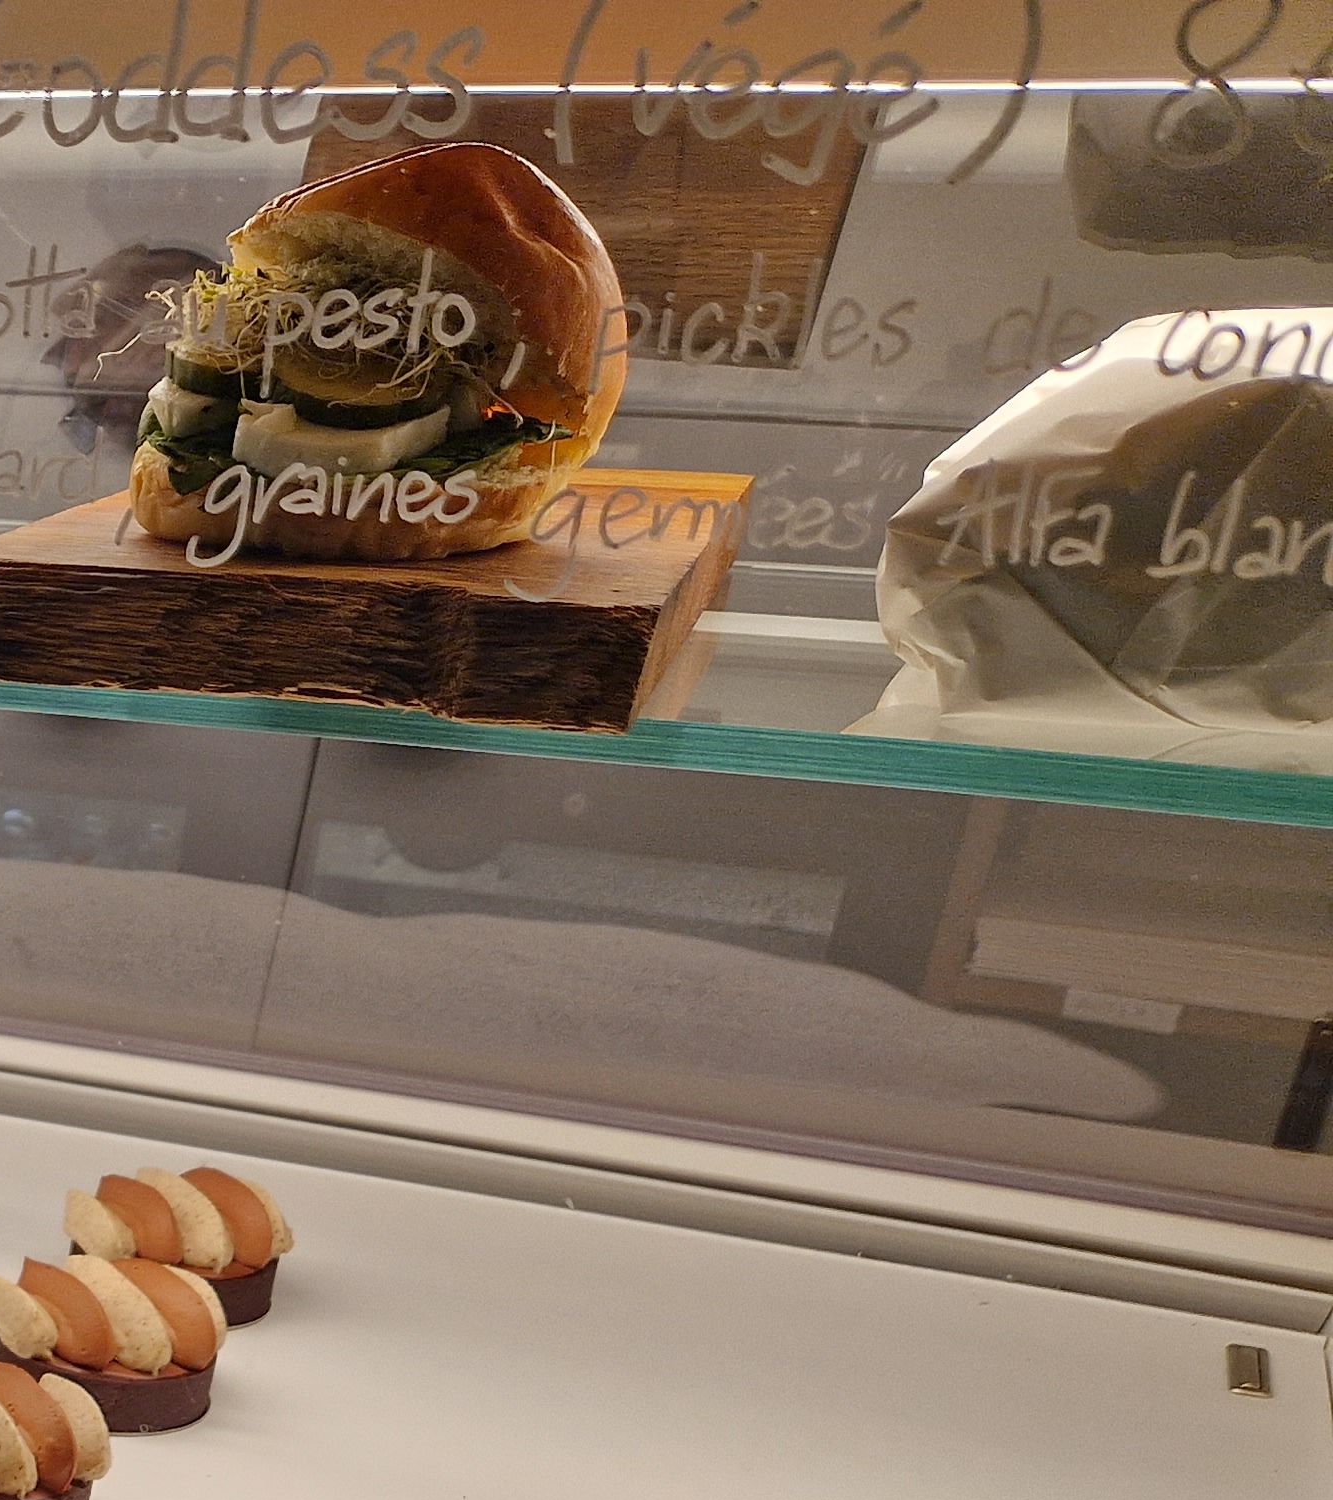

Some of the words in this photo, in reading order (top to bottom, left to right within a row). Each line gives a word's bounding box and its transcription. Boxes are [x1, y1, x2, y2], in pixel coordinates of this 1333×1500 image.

[587, 251, 915, 393] pickles
[984, 276, 1105, 376] de
[186, 454, 479, 568] graines
